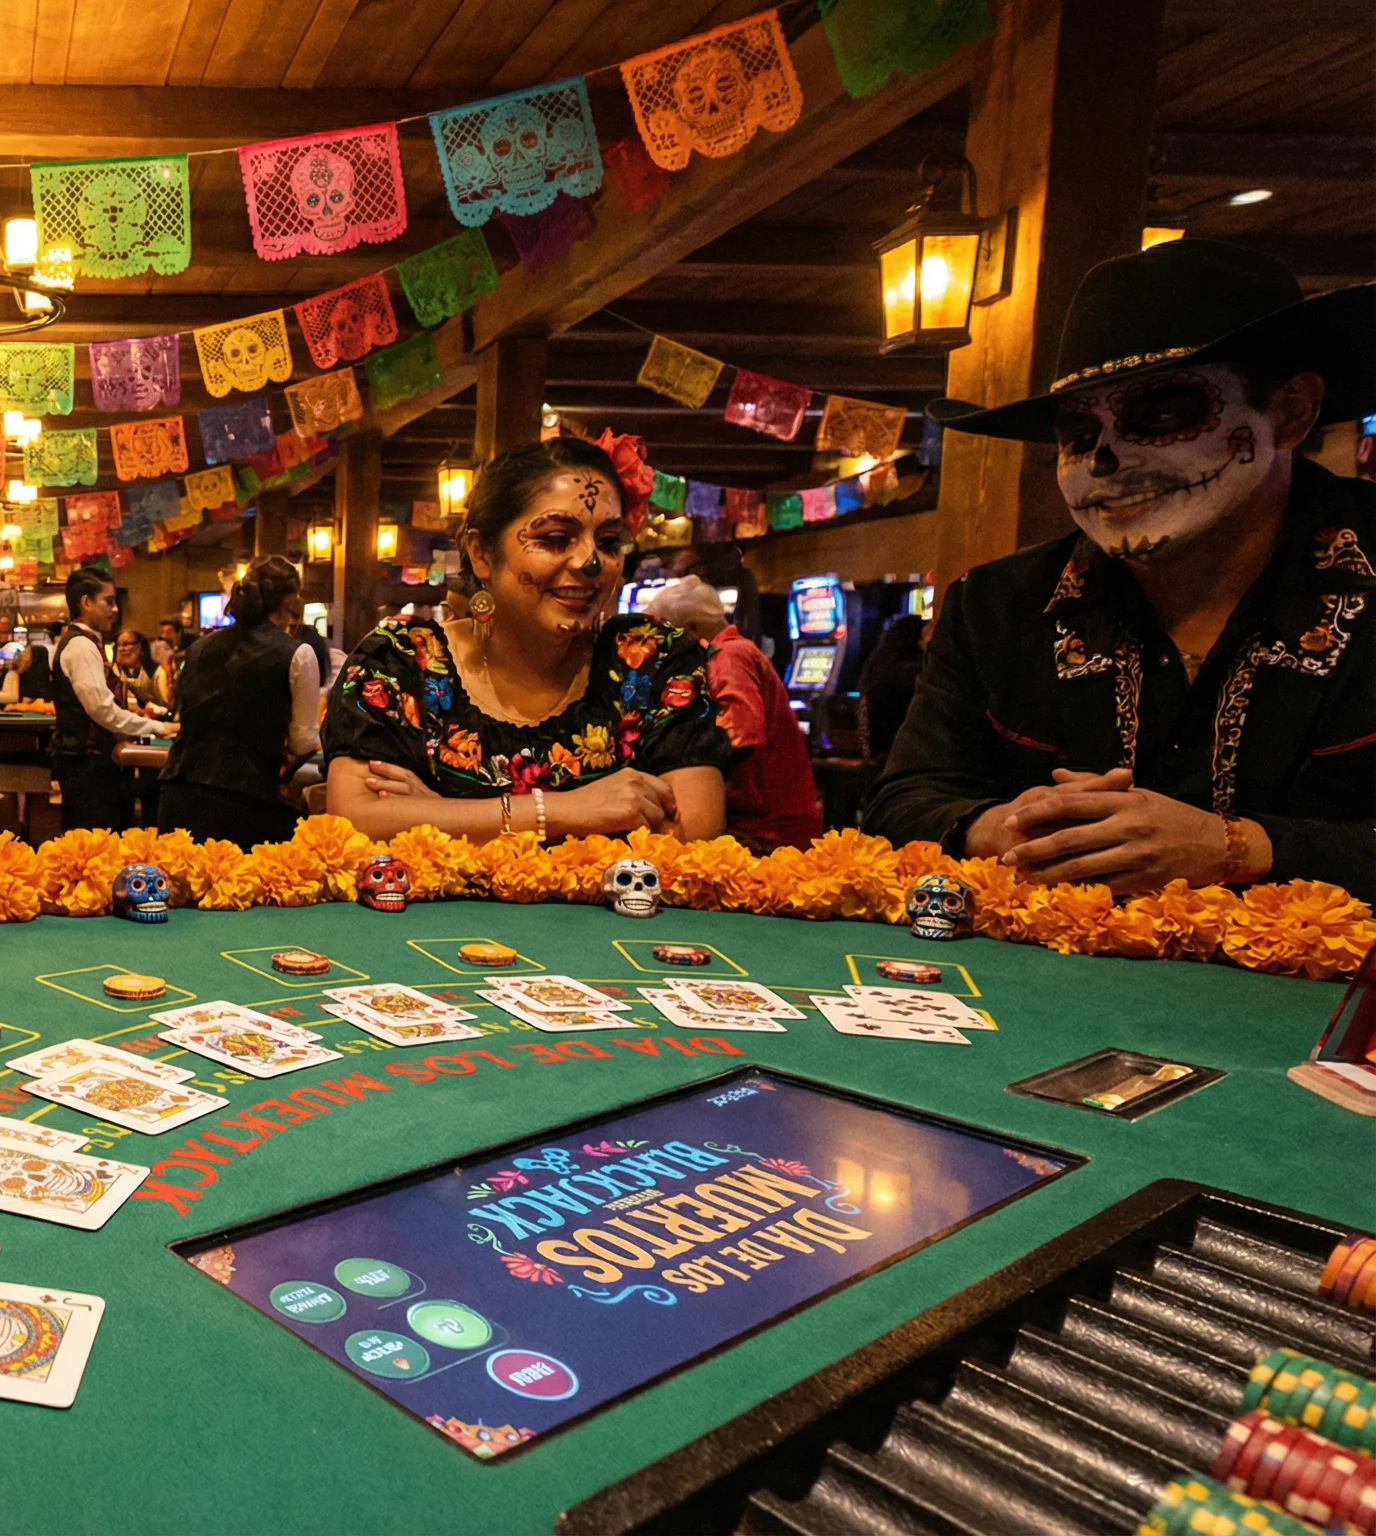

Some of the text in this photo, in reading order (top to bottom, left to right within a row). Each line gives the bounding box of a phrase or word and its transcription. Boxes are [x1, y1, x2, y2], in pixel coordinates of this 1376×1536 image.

[383, 1049, 517, 1083] LOS
[508, 1040, 615, 1064] DE
[468, 1140, 730, 1240] BLACKJACK
[536, 1164, 821, 1283] MUERTOS
[718, 1238, 785, 1271] DE
[661, 1255, 751, 1293] LOS
